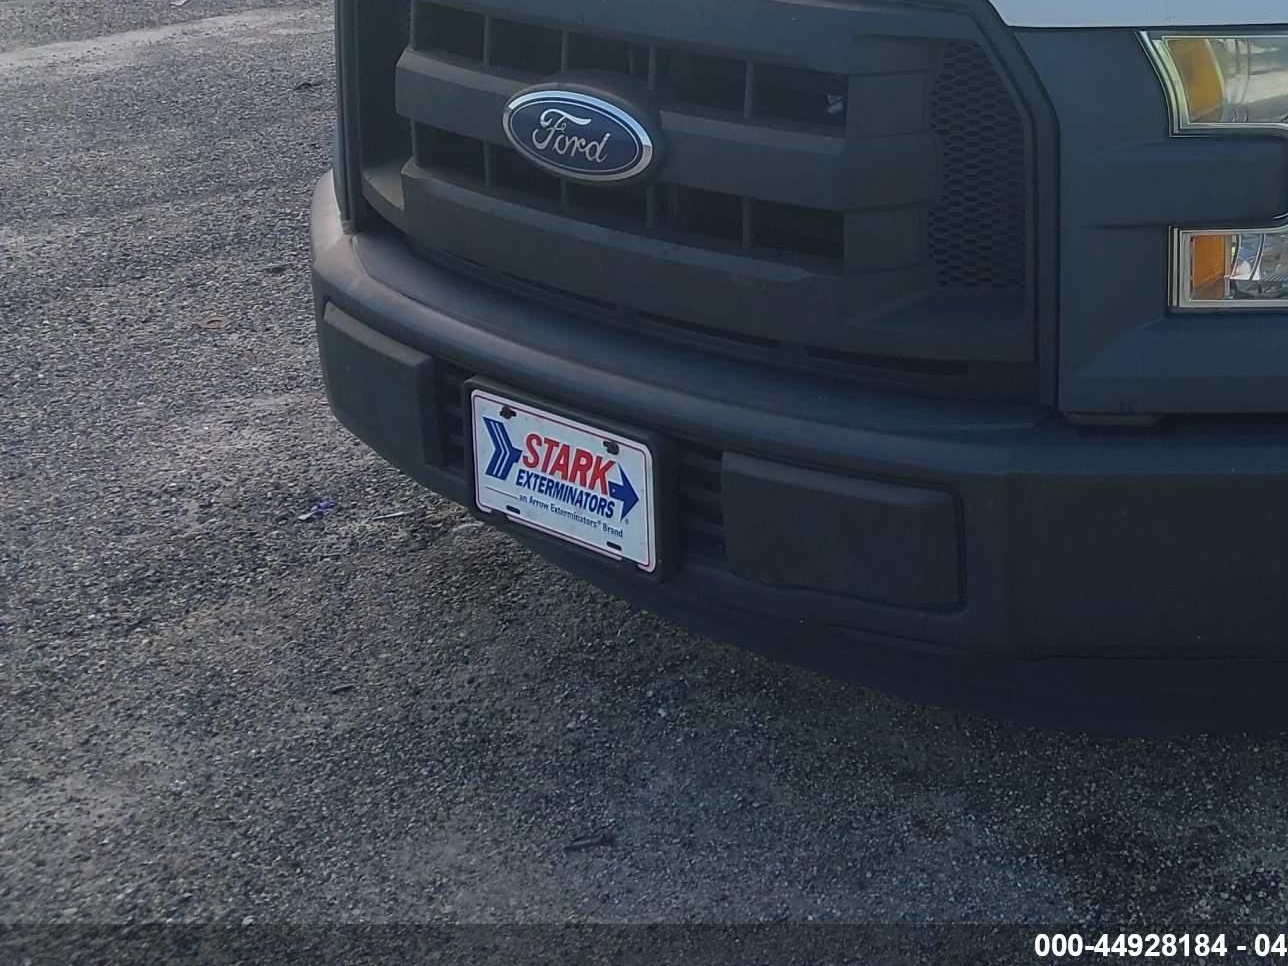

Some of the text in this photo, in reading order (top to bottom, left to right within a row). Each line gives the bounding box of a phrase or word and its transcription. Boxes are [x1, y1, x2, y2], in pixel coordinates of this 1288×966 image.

[532, 108, 611, 163] Ford
[522, 433, 616, 496] STARK
[516, 468, 616, 520] EXTERMINATORS
[529, 496, 549, 510] Arrow
[602, 521, 624, 538] Brand
